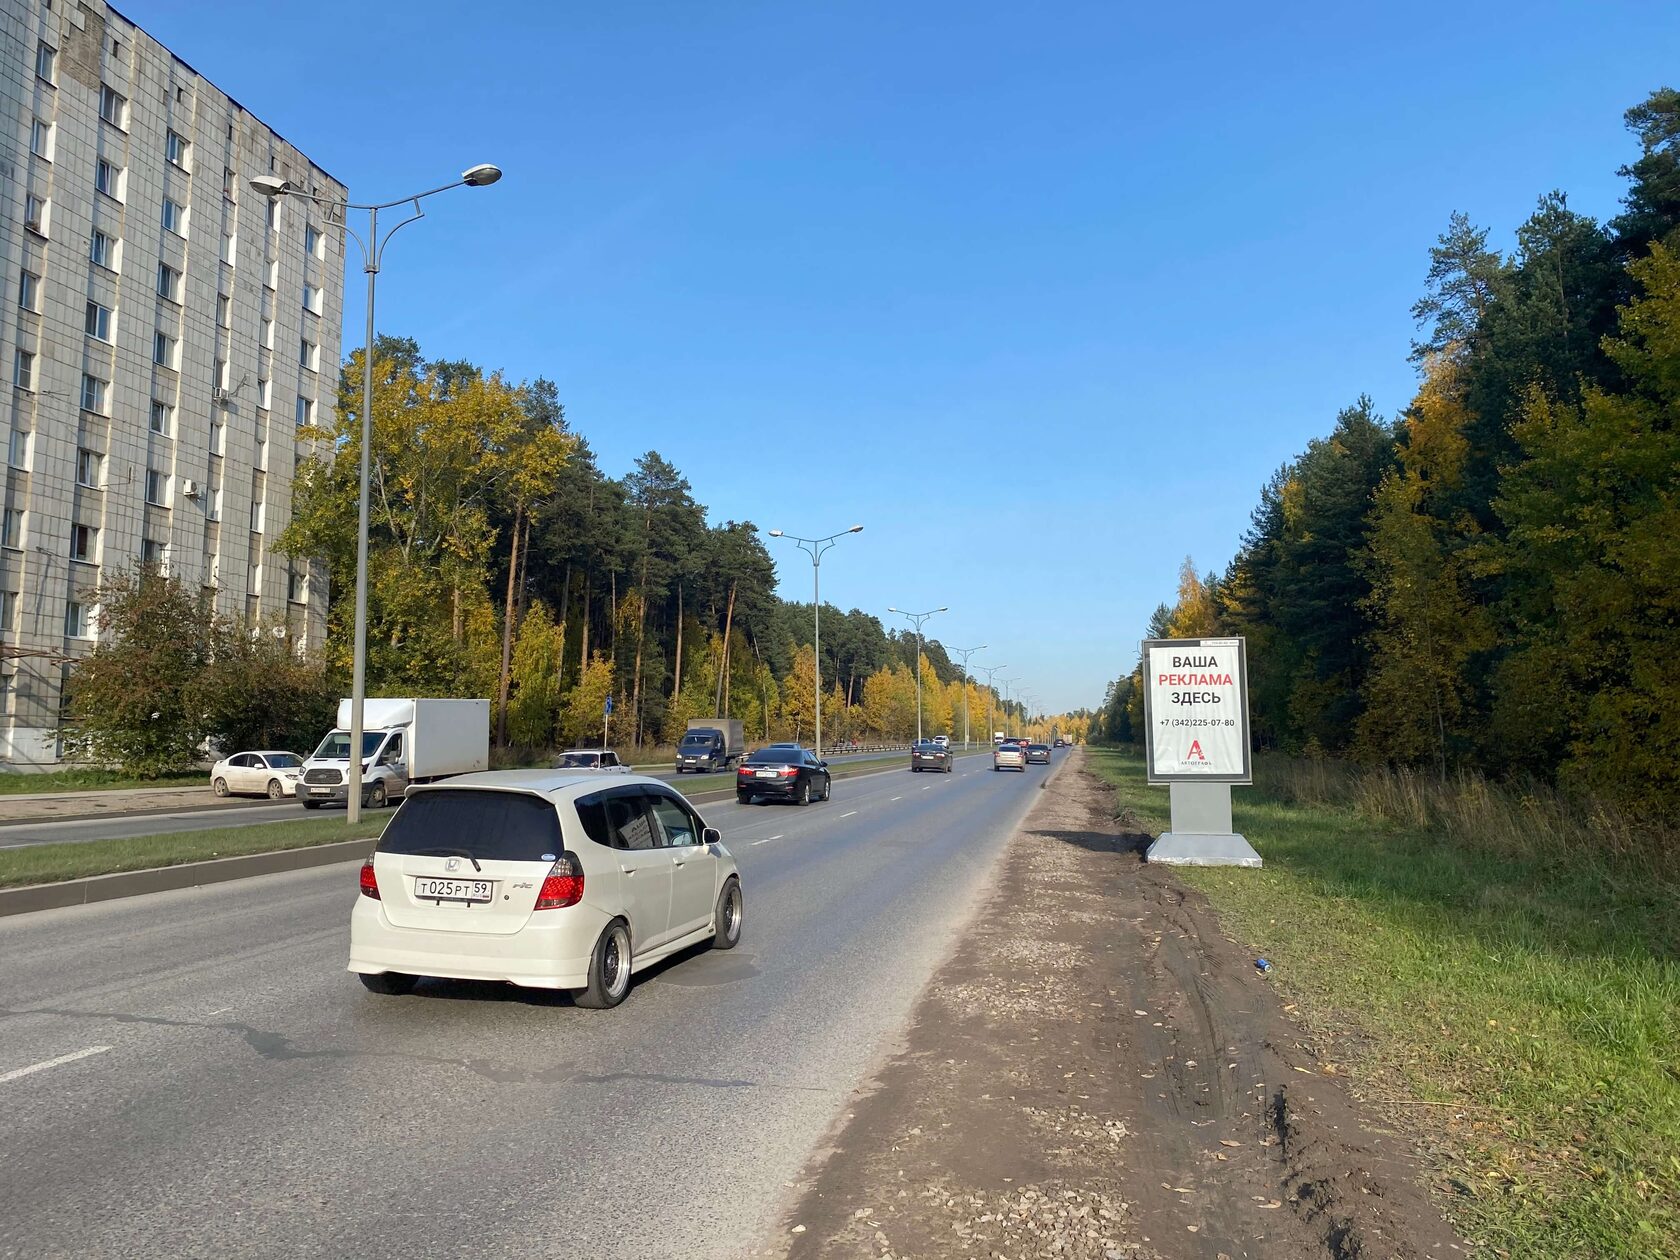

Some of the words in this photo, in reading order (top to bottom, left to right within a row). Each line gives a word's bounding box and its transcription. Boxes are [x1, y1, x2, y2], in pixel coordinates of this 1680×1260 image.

[1172, 656, 1218, 668] ВАША
[1159, 673, 1233, 686] РЕКЛАМА
[1171, 692, 1221, 706] ЗДЕСЬ
[1171, 718, 1235, 727] (342)225-07-80
[474, 882, 487, 894] 59
